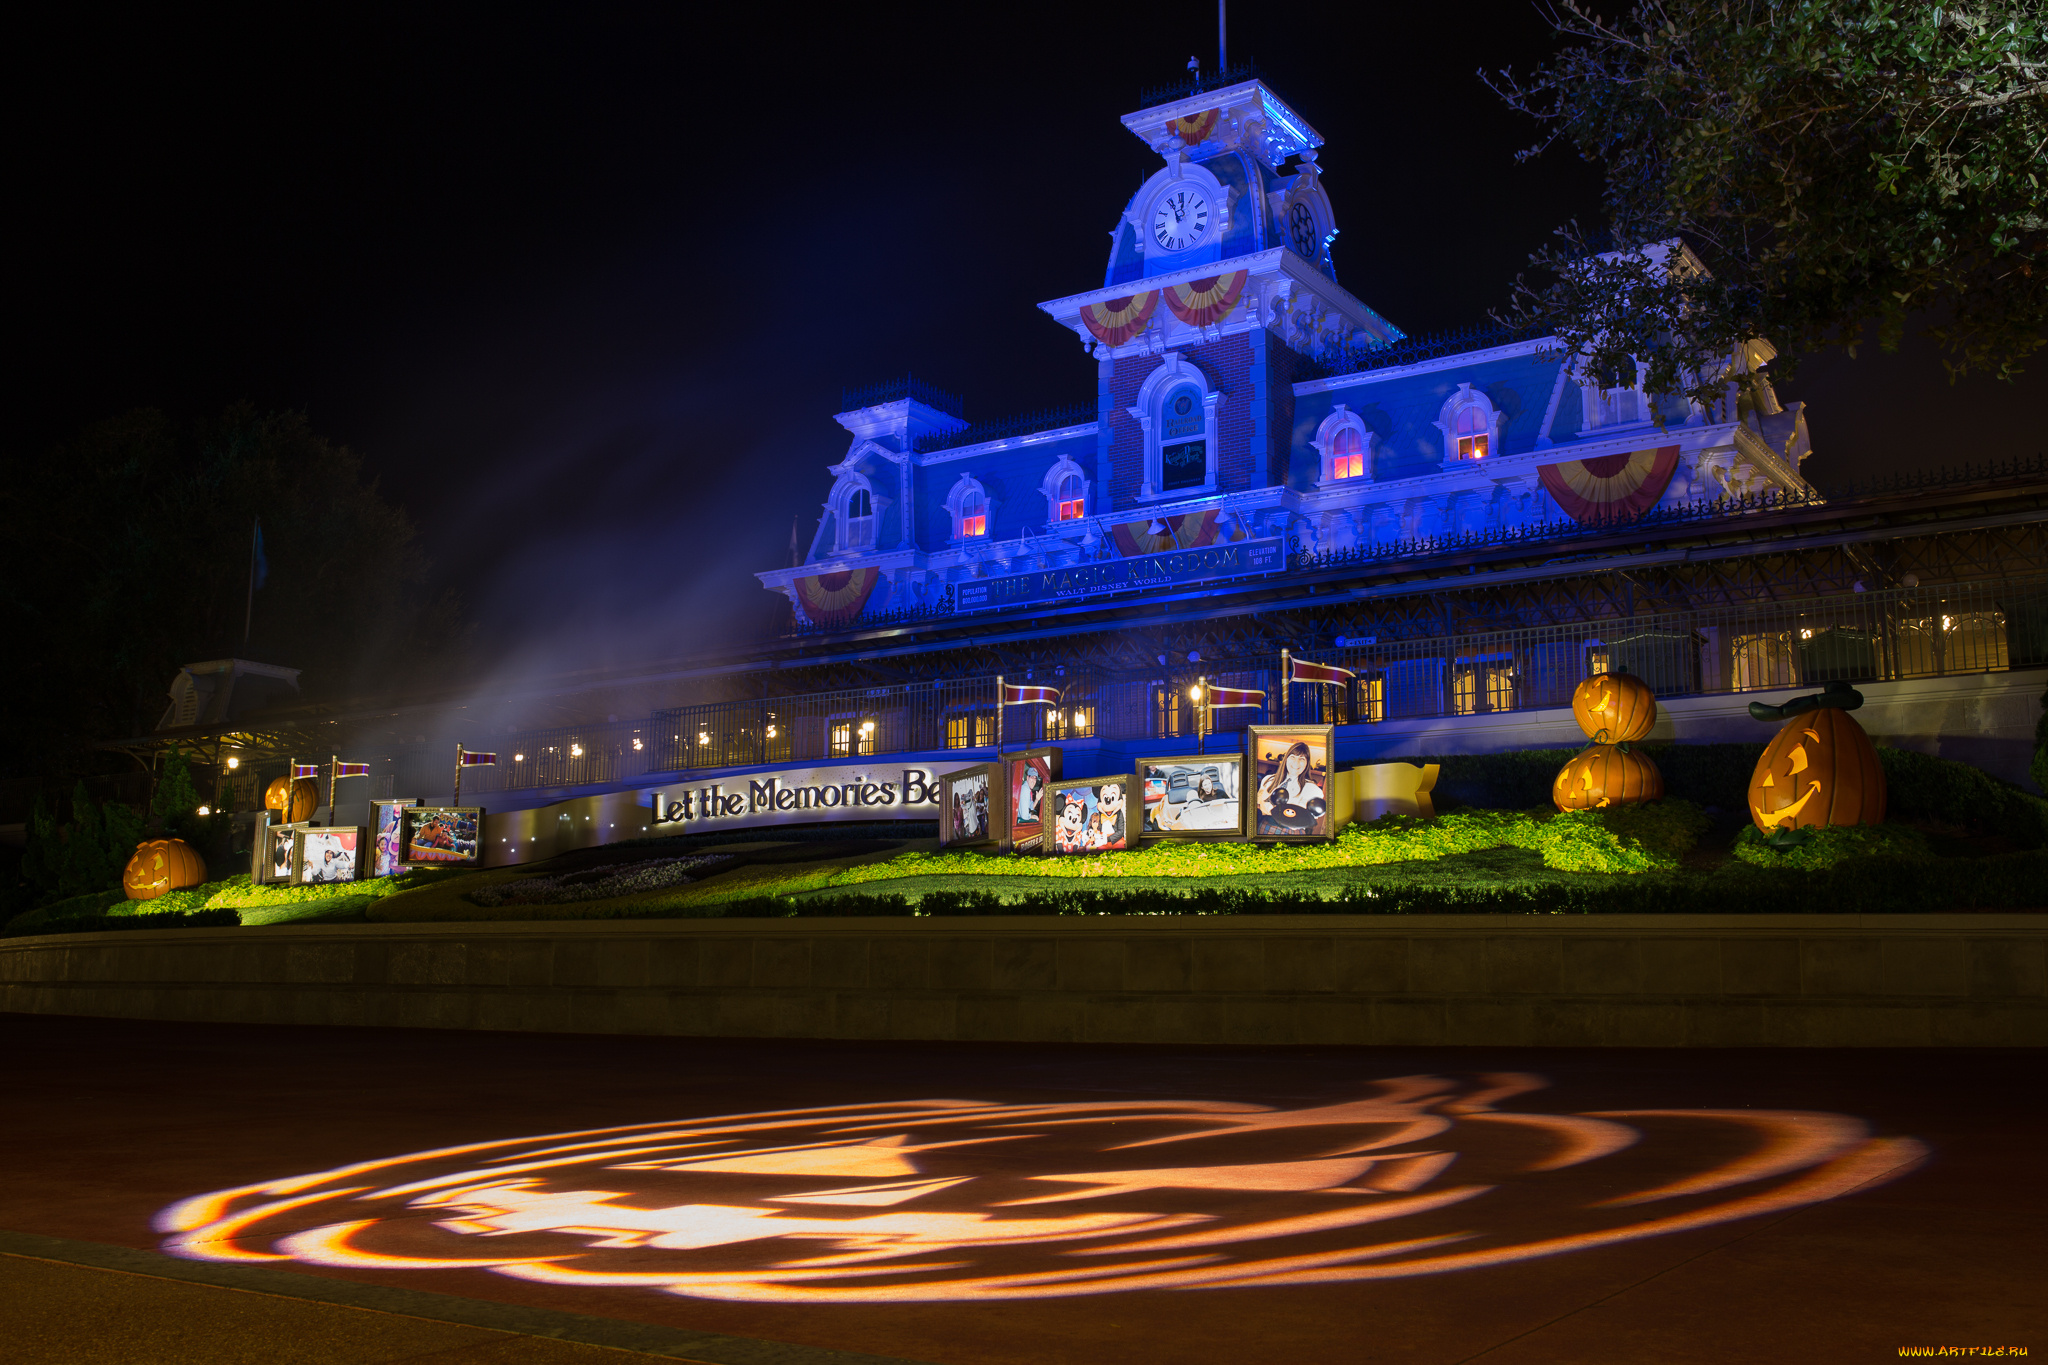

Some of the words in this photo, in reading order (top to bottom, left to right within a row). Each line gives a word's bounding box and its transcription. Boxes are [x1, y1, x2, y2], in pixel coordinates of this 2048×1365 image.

[1249, 545, 1277, 557] ELEVATION
[992, 576, 1030, 598] THE
[1042, 565, 1115, 592] MAGIC
[1127, 547, 1241, 580] KINGDOM
[1055, 587, 1086, 597] WALT
[1089, 581, 1129, 592] DISNEY
[1133, 575, 1172, 586] WORLD
[651, 790, 694, 824] Let
[700, 784, 743, 818] the
[748, 775, 895, 813] Memories
